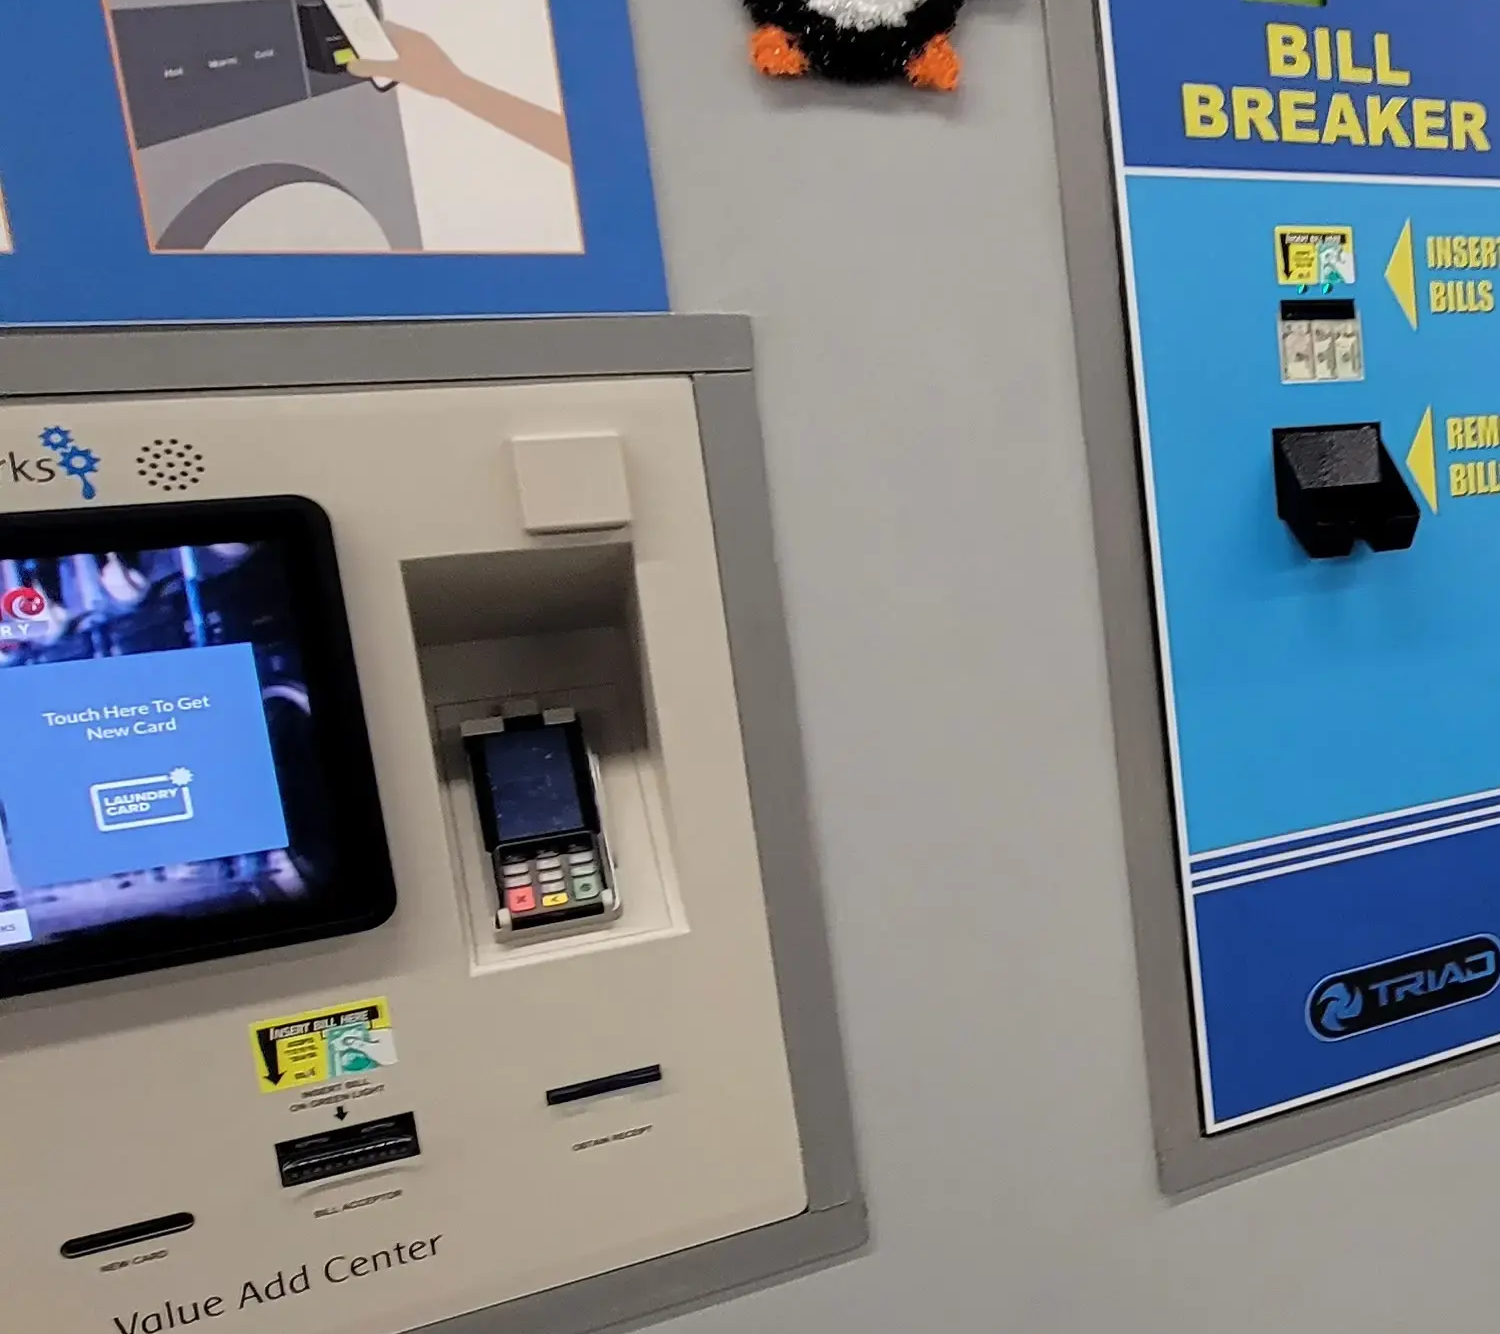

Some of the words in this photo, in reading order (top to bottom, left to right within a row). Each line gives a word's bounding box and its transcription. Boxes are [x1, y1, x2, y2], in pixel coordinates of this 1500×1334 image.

[1266, 22, 1411, 87] BILL
[1182, 83, 1491, 153] BREAKER
[1430, 280, 1494, 313] BILLS
[42, 707, 100, 726] Touch
[103, 704, 149, 720] Here
[152, 699, 174, 714] To
[177, 695, 211, 710] Get
[86, 725, 129, 741] New
[133, 717, 177, 735] Card
[103, 787, 178, 806] LAUNDRY
[105, 802, 151, 816] CARD
[1368, 950, 1496, 1007] TRIAD
[269, 1022, 312, 1041] INSERT
[313, 1016, 337, 1031] BILL
[340, 1010, 370, 1024] HERE
[238, 1264, 310, 1310] Add
[324, 1234, 443, 1283] Center
